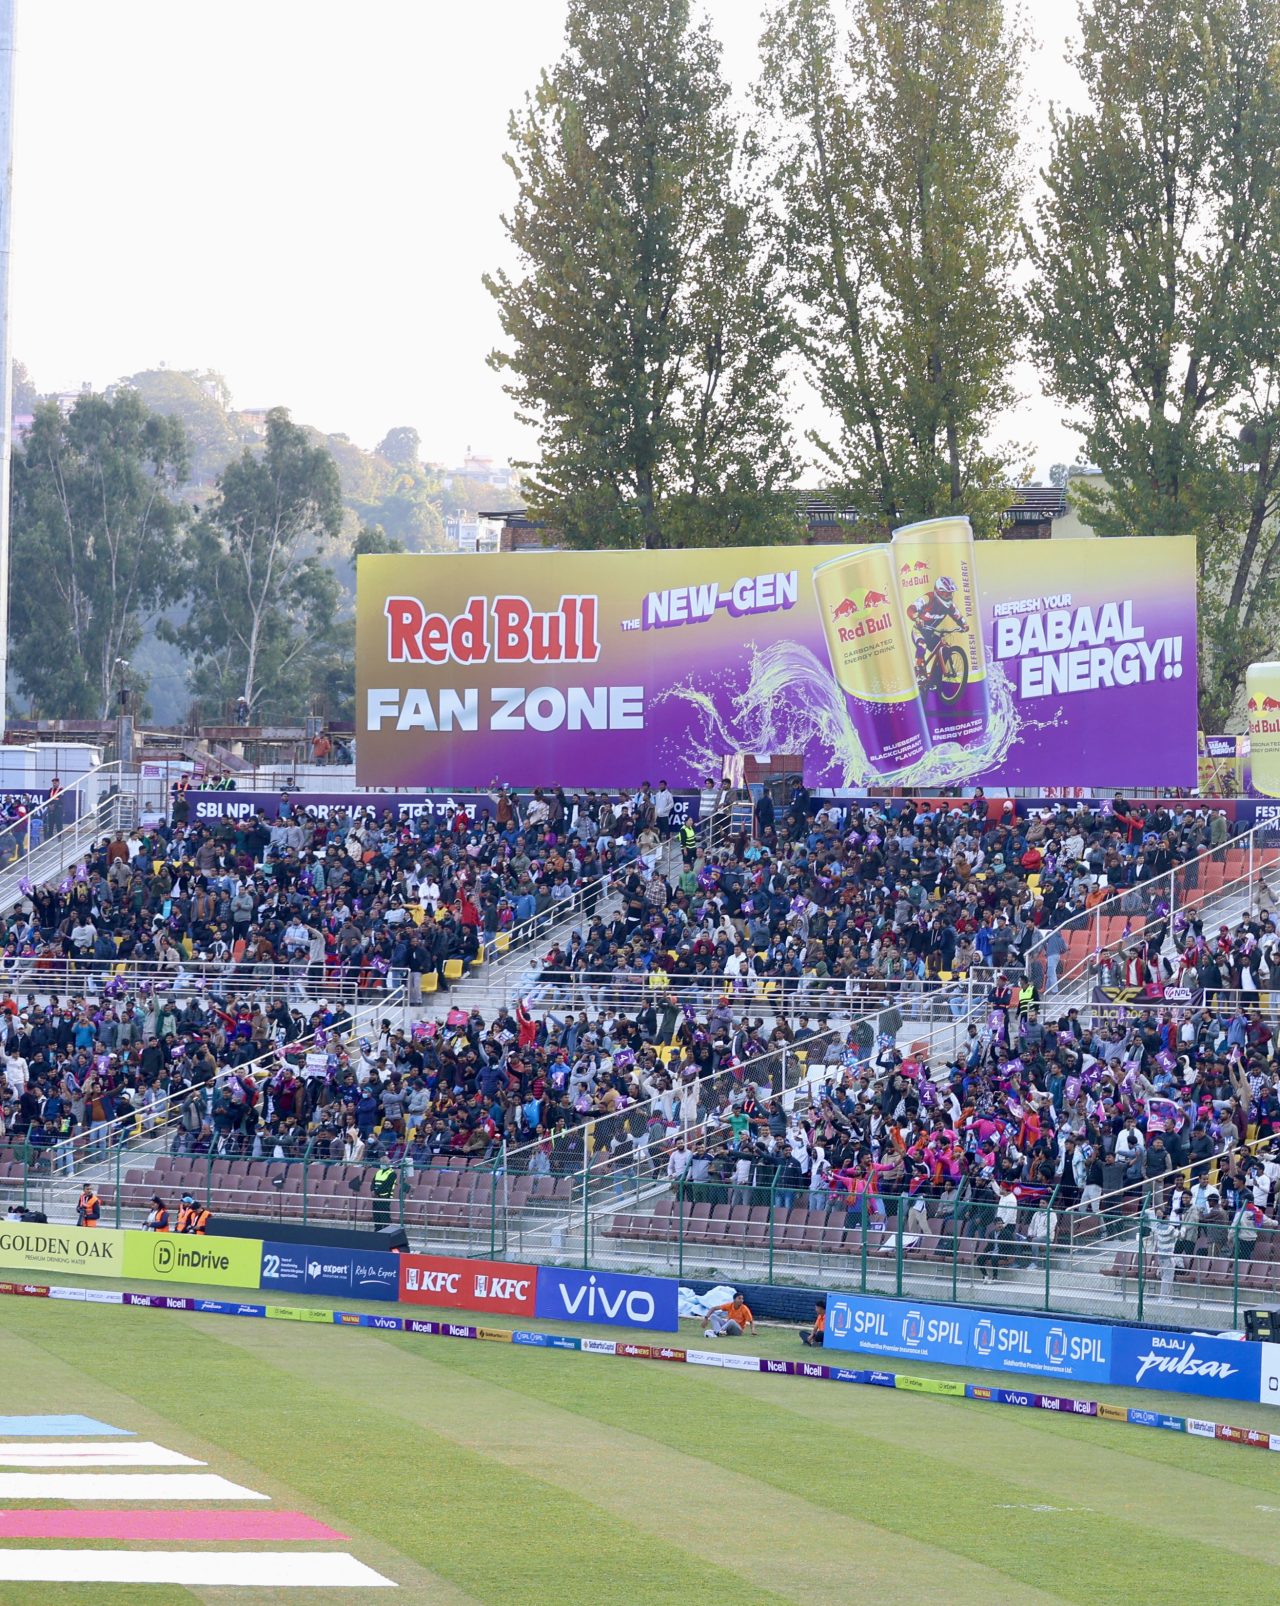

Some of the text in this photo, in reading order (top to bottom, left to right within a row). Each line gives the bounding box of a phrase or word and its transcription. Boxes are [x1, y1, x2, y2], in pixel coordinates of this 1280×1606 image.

[622, 571, 798, 632] THE NEW-GEN
[993, 594, 1072, 616] REFRESH YOUR
[960, 561, 979, 671] REFRESH YOUR ENERGY
[384, 595, 600, 665] Red Bull
[838, 613, 892, 642] Red Bull
[995, 600, 1145, 660] BABAAL
[844, 638, 893, 658] CARBONATED
[844, 645, 895, 665] ENERGY DRINK
[1019, 636, 1183, 699] ENERGY!!
[367, 686, 644, 731] FAN ZONE
[932, 725, 983, 741] ENERGY DRINK
[934, 719, 983, 734] CARBONATED
[870, 740, 922, 761] BLACKCURRANT
[883, 734, 921, 752] BLUEBERRY
[895, 746, 924, 762] FLAVOUR
[61, 881, 68, 889] 4
[992, 1016, 998, 1025] 4
[316, 1033, 322, 1041] 4
[98, 1062, 105, 1070] 4
[1163, 1058, 1170, 1066] 4
[233, 1083, 240, 1091] 4
[1068, 1084, 1074, 1094] 4
[923, 1090, 930, 1100] 4
[0, 1234, 114, 1258] GOLDEN OAK
[47, 1256, 70, 1264] DRINKING
[177, 1252, 229, 1271] inDrive
[263, 1254, 280, 1278] 22
[323, 1264, 348, 1275] expert
[355, 1265, 367, 1278] Rely
[368, 1266, 376, 1277] On
[378, 1268, 397, 1278] Expert
[420, 1271, 460, 1293] KFC
[489, 1278, 530, 1300] KFC
[131, 1295, 151, 1306] Ncell
[167, 1298, 186, 1309] Ncell
[559, 1275, 655, 1322] vivo
[375, 1317, 396, 1329] vivo
[412, 1322, 431, 1333] Ncell
[854, 1310, 888, 1336] SPIL
[450, 1325, 469, 1337] Ncell
[927, 1319, 963, 1346] SPIL
[998, 1328, 1032, 1354] SPIL
[1152, 1337, 1185, 1350] BAJAJ
[882, 1344, 899, 1352] Premier
[899, 1346, 920, 1355] Insurance
[1070, 1336, 1105, 1363] SPIL
[768, 1361, 786, 1372] Ncell
[804, 1364, 822, 1376] Ncell
[1026, 1362, 1043, 1370] Premier
[1043, 1364, 1063, 1373] Insurance
[1135, 1342, 1239, 1383] pulsar
[1005, 1393, 1027, 1405] vivo
[1042, 1397, 1059, 1410] Ncell
[1073, 1400, 1091, 1413] Ncell
